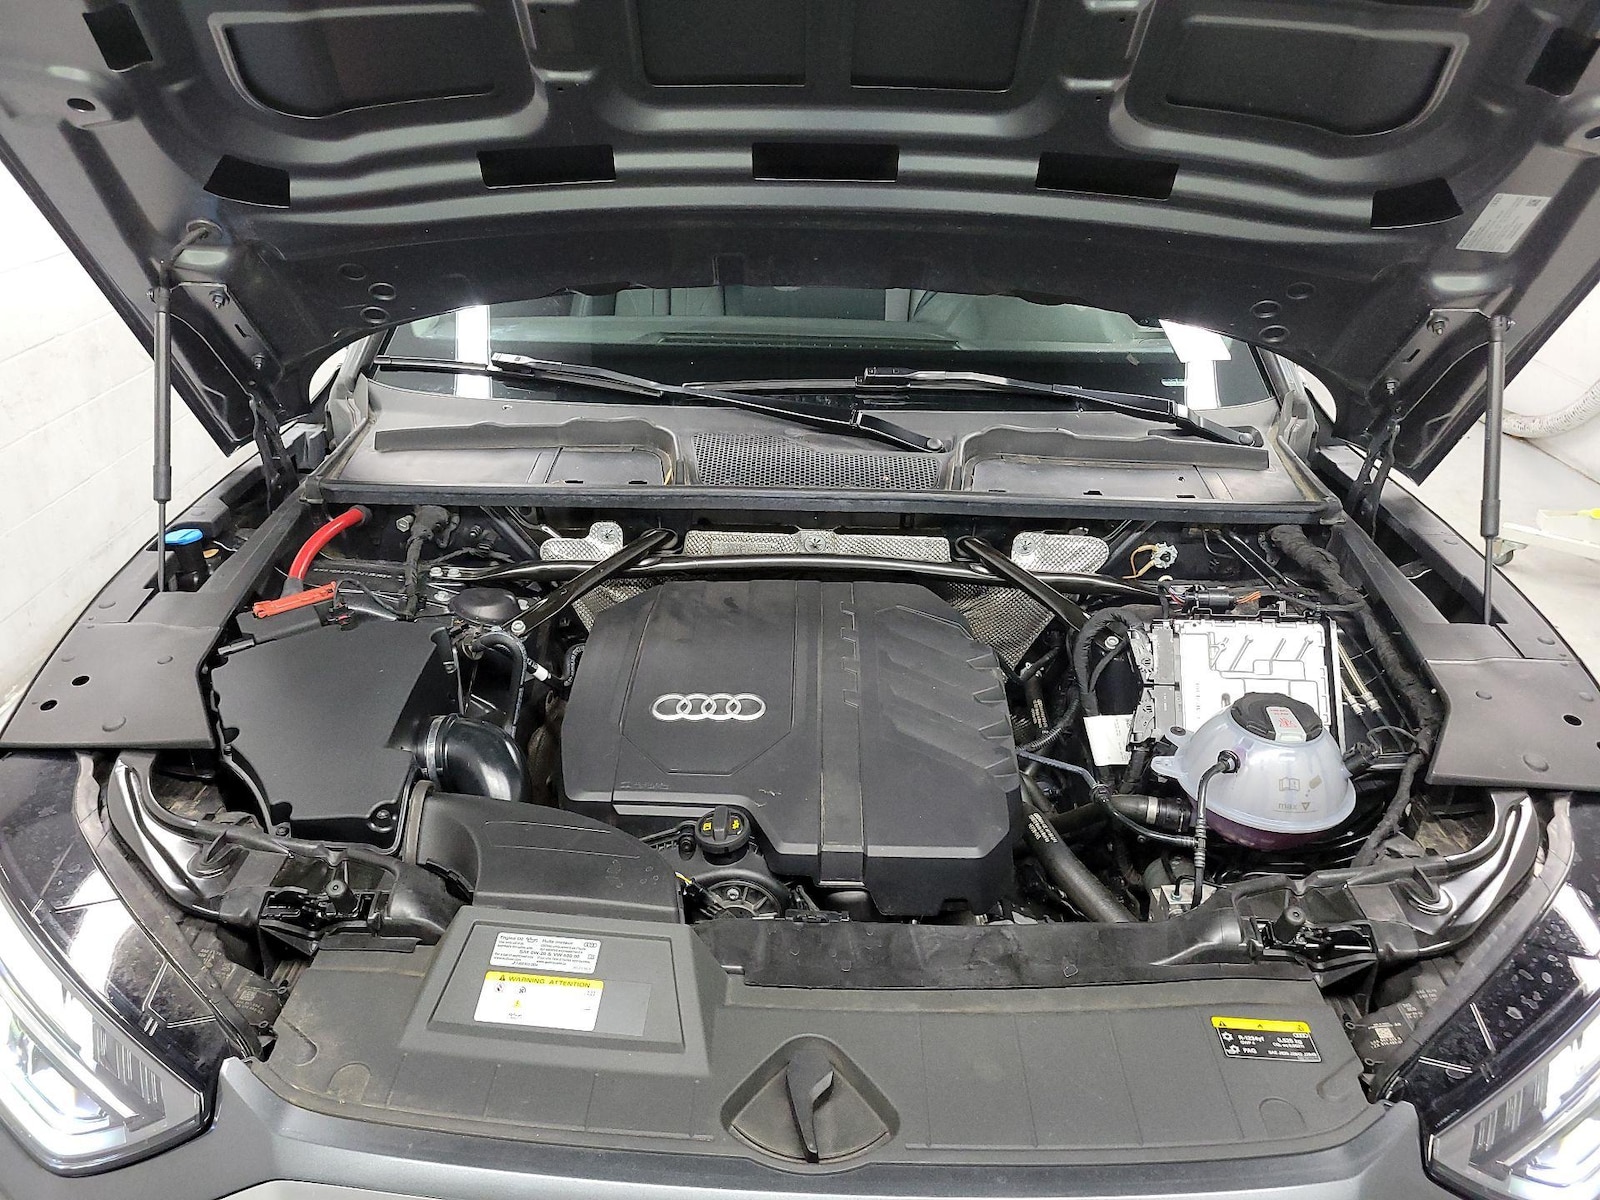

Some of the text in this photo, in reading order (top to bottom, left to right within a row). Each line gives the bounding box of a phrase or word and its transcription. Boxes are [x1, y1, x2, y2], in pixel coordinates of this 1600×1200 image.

[1278, 802, 1297, 810] max
[508, 976, 590, 989] WARNING ATTENTION
